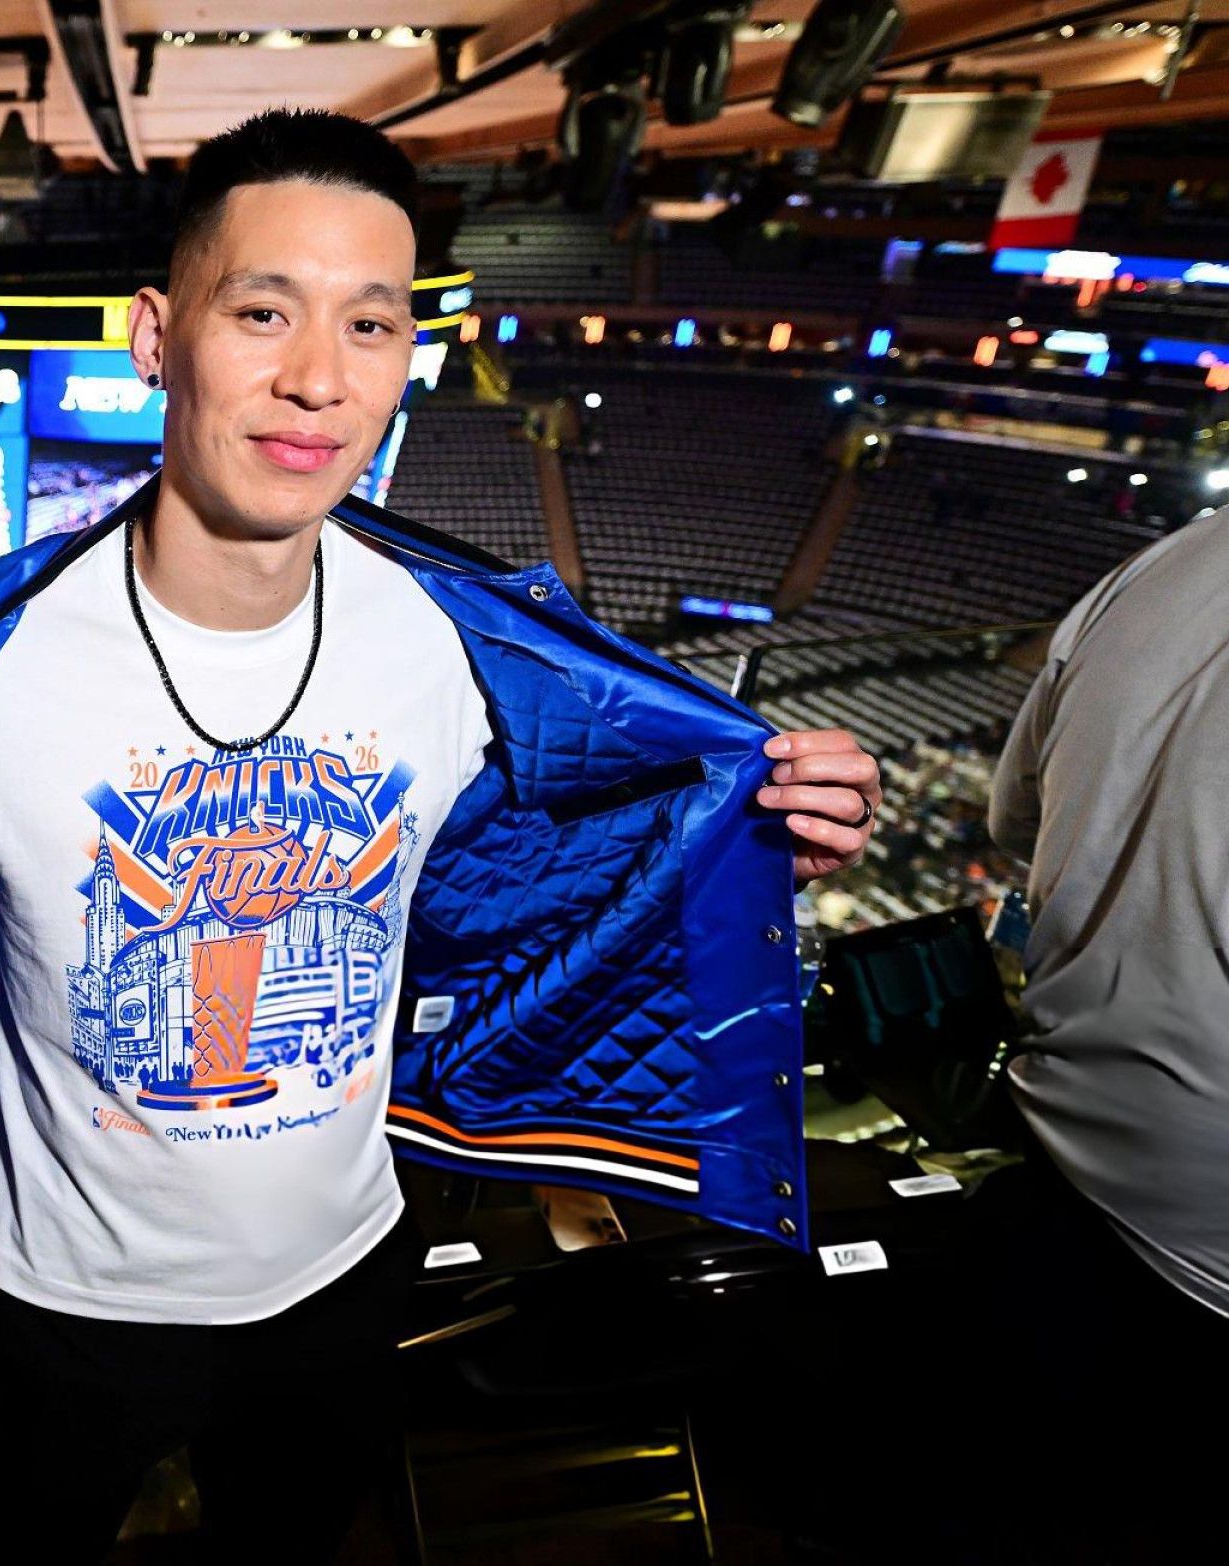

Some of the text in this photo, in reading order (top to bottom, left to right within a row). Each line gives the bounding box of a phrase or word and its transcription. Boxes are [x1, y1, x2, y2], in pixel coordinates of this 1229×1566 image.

[259, 735, 307, 757] YORK
[355, 745, 380, 772] 26
[130, 762, 159, 788] 20
[134, 750, 374, 857] KNICKS
[140, 829, 351, 932] Finals
[165, 1126, 212, 1142] New
